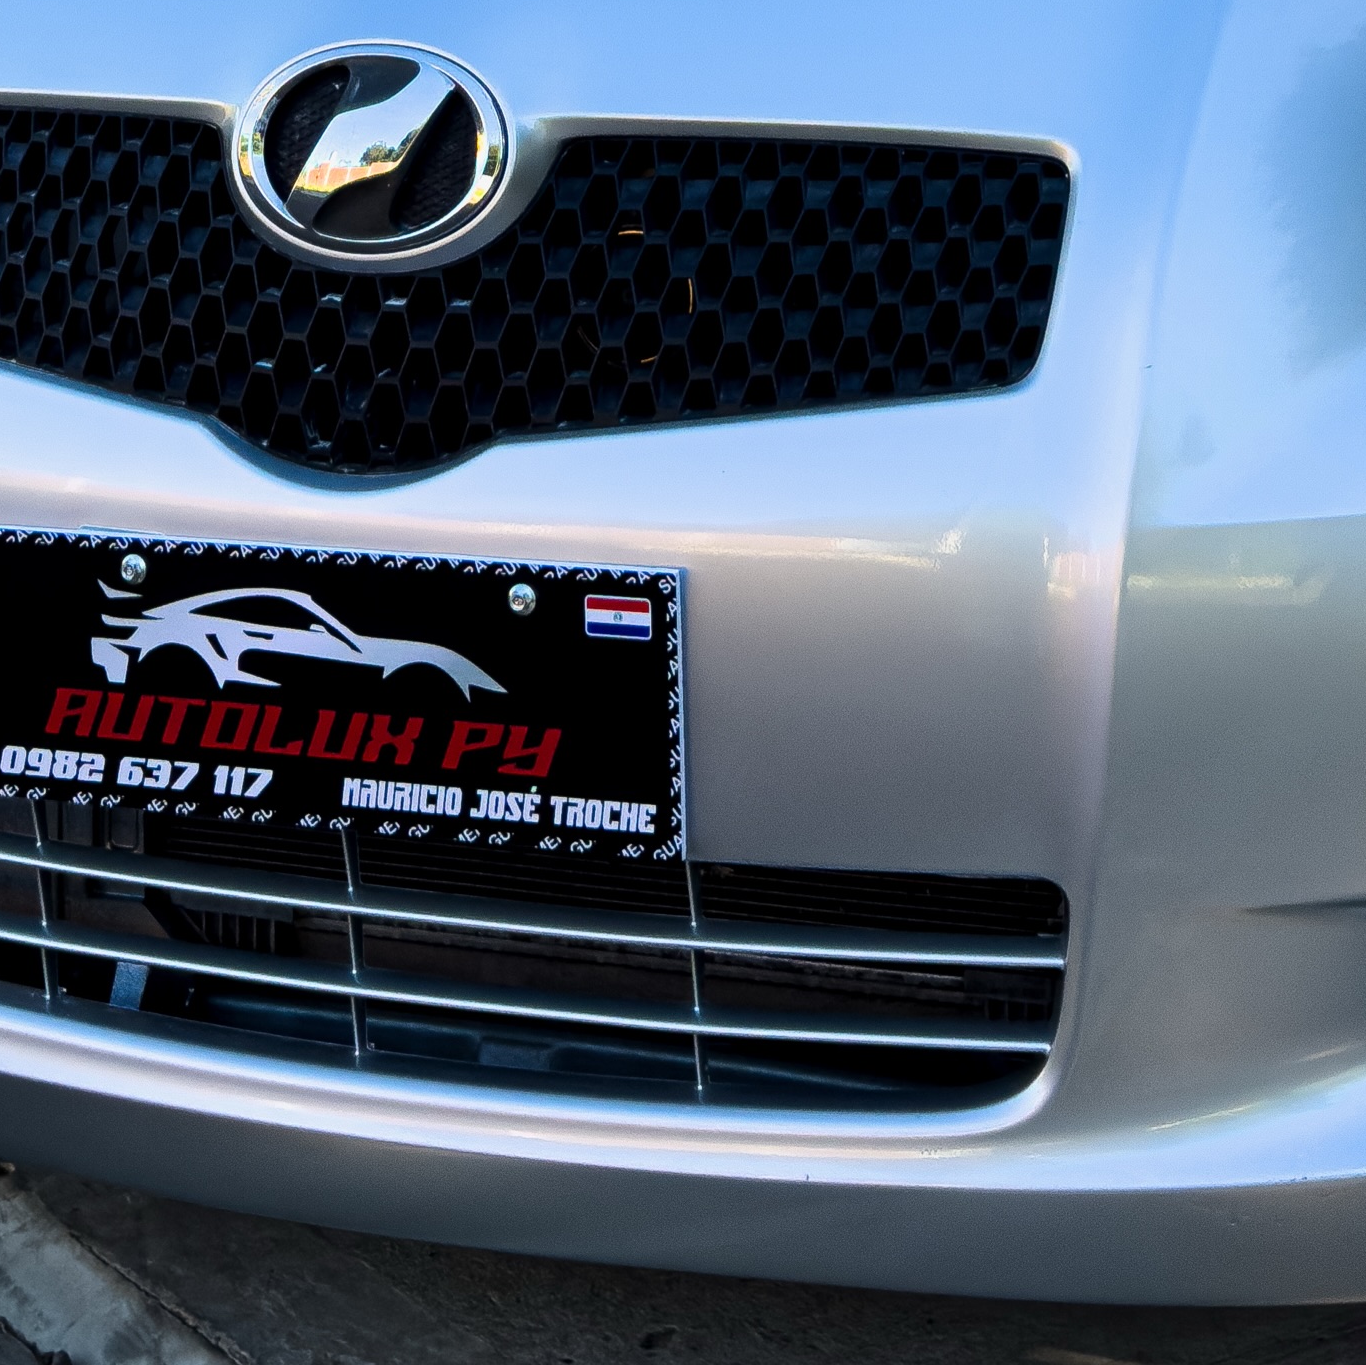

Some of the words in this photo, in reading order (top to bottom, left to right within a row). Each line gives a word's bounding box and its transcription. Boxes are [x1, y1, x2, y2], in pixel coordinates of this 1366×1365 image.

[44, 687, 424, 765] AUTOLUX
[441, 720, 563, 777] PY
[0, 745, 106, 783] 0982
[116, 756, 200, 791] 637
[213, 765, 274, 798] 117
[341, 777, 463, 817] MAURICIO
[470, 785, 542, 824] JOSÉ
[549, 795, 657, 834] TROCHE
